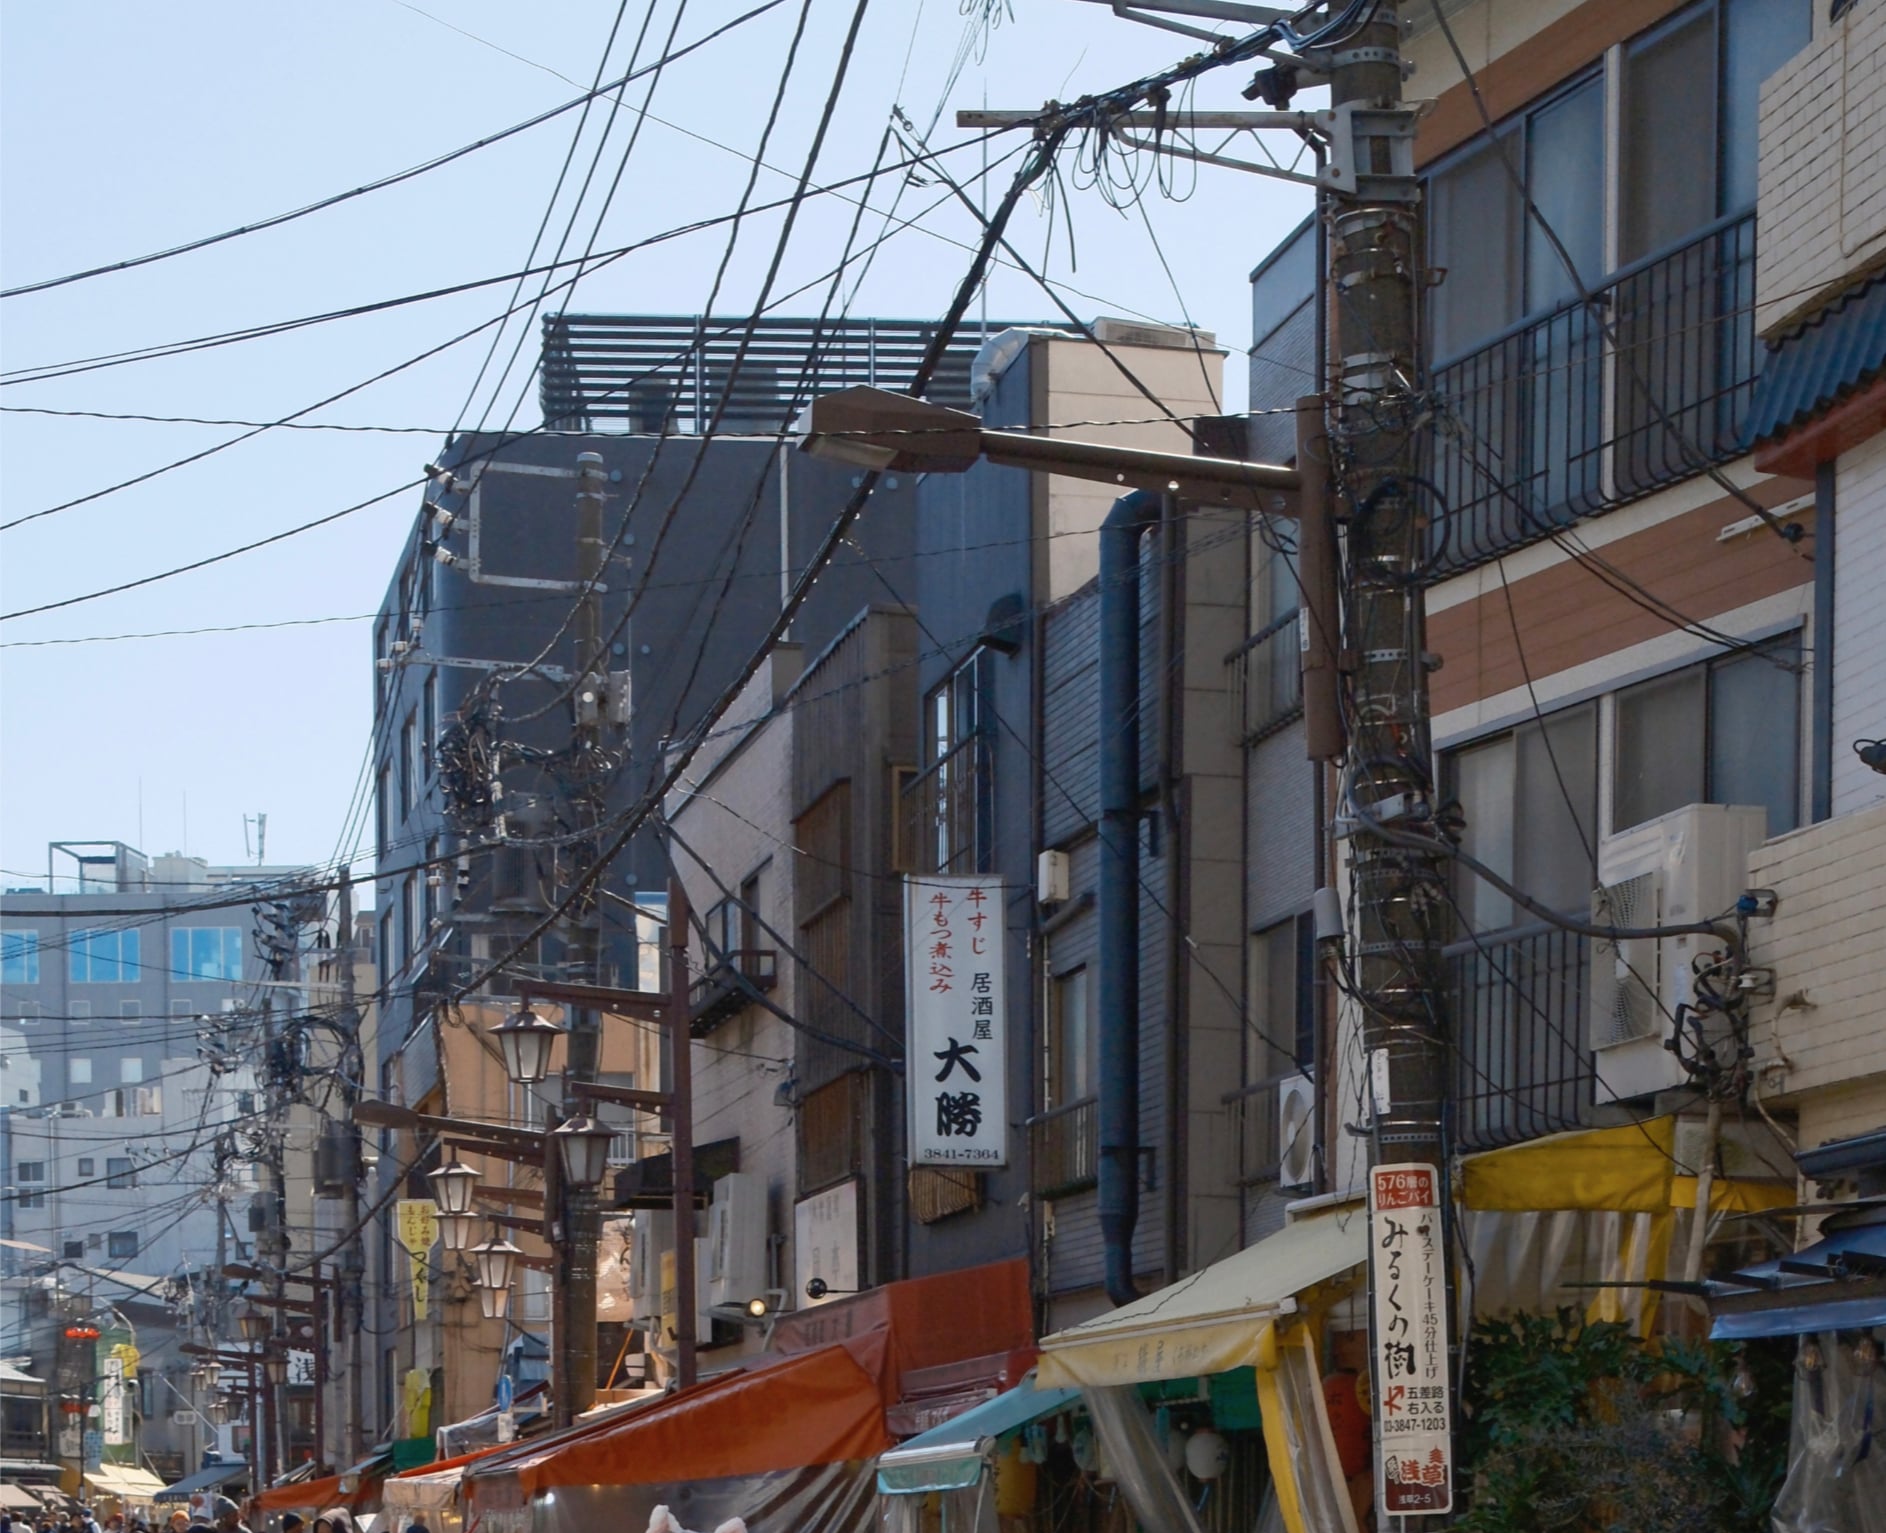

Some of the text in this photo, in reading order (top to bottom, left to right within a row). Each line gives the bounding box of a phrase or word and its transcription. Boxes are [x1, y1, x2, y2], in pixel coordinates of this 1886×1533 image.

[966, 887, 988, 955] 牛すじ
[929, 892, 954, 994] 牛もつ煮込み
[970, 972, 993, 1040] 居酒屋
[934, 1036, 982, 1138] 大勝
[924, 1148, 999, 1161] 3841-7364
[1378, 1190, 1430, 1207] りんごパイ
[1407, 1386, 1445, 1400] 五差路
[1407, 1401, 1445, 1415] 右入る
[1384, 1417, 1446, 1433] 03-3847-1203
